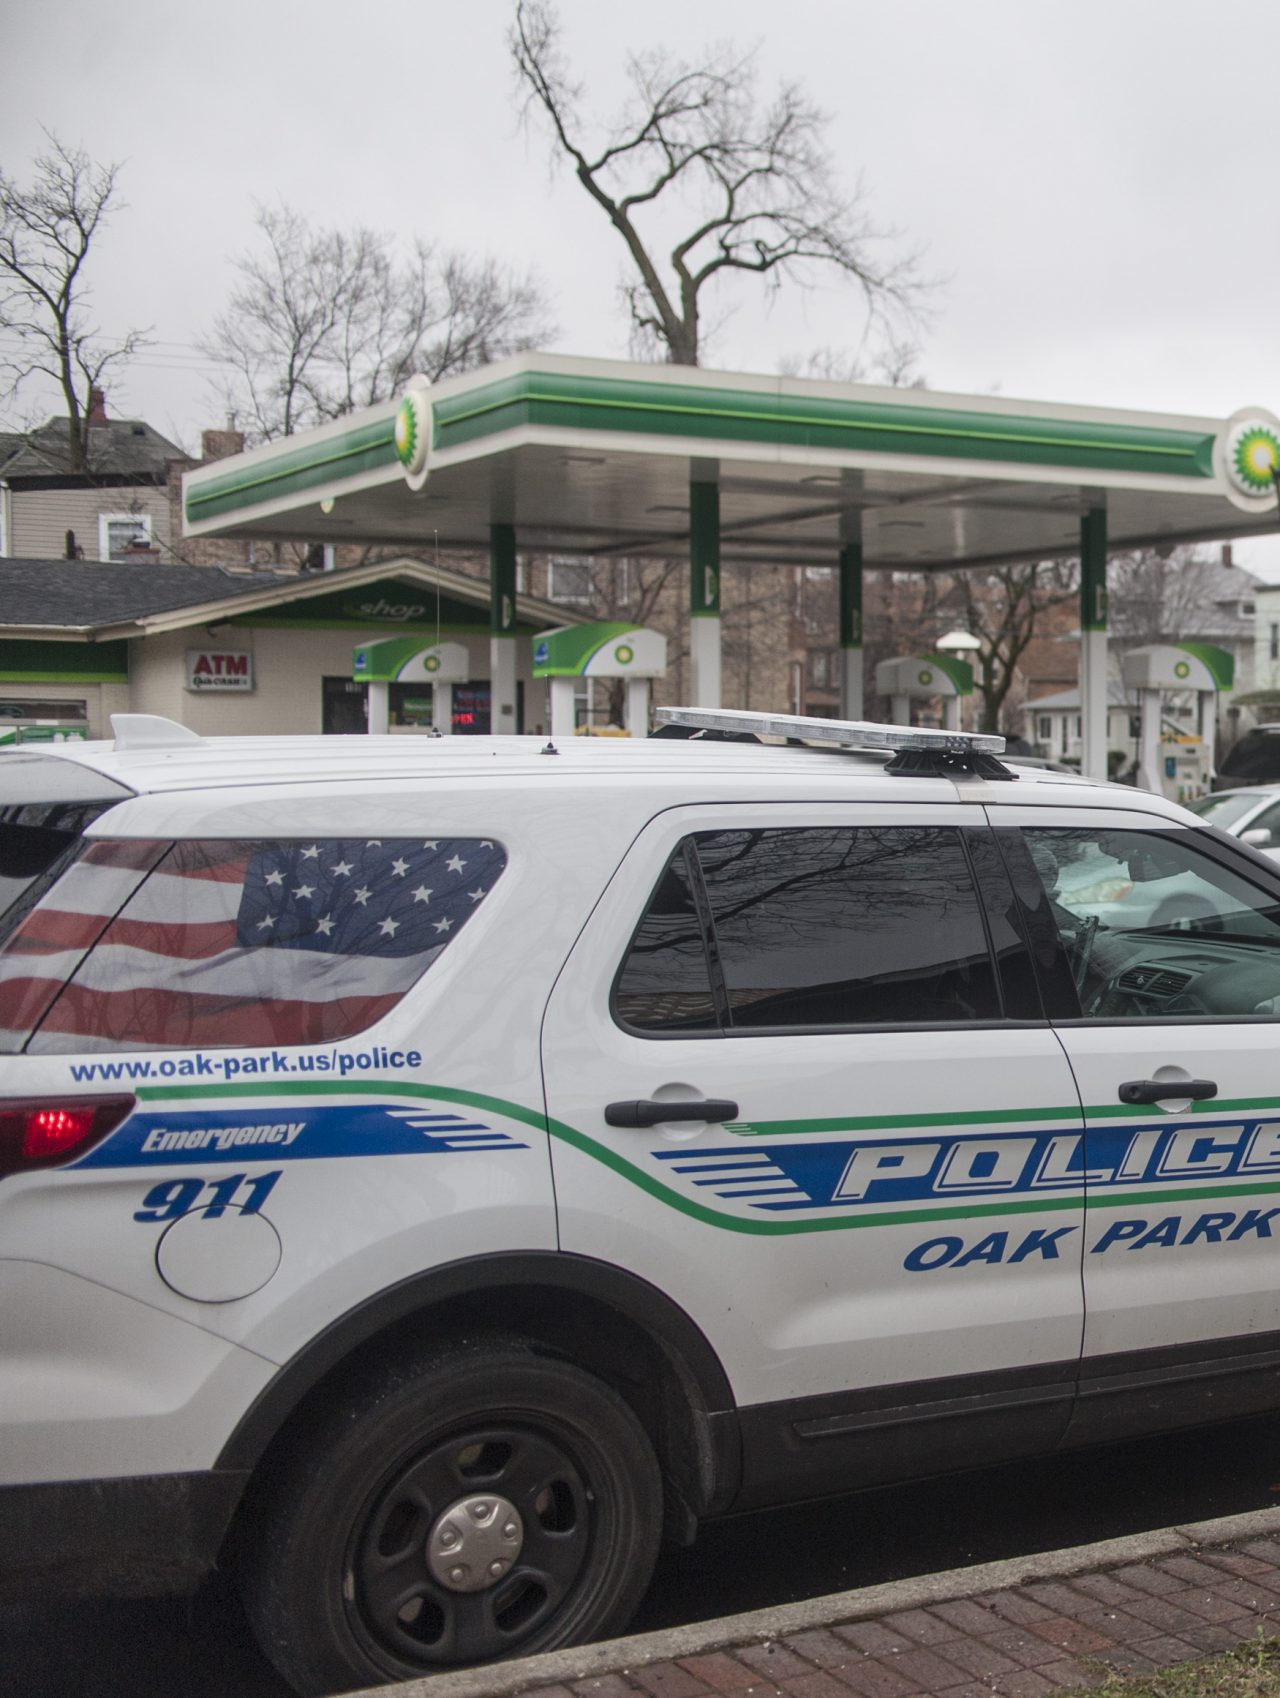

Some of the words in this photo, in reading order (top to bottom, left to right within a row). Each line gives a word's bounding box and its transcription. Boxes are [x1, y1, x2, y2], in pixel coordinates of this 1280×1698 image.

[360, 599, 425, 622] shop
[193, 654, 248, 676] ATM
[70, 1047, 422, 1082] www.oak-park.us/police
[141, 1122, 306, 1152] Emergency
[133, 1169, 284, 1224] 911
[902, 1225, 1080, 1272] OAK
